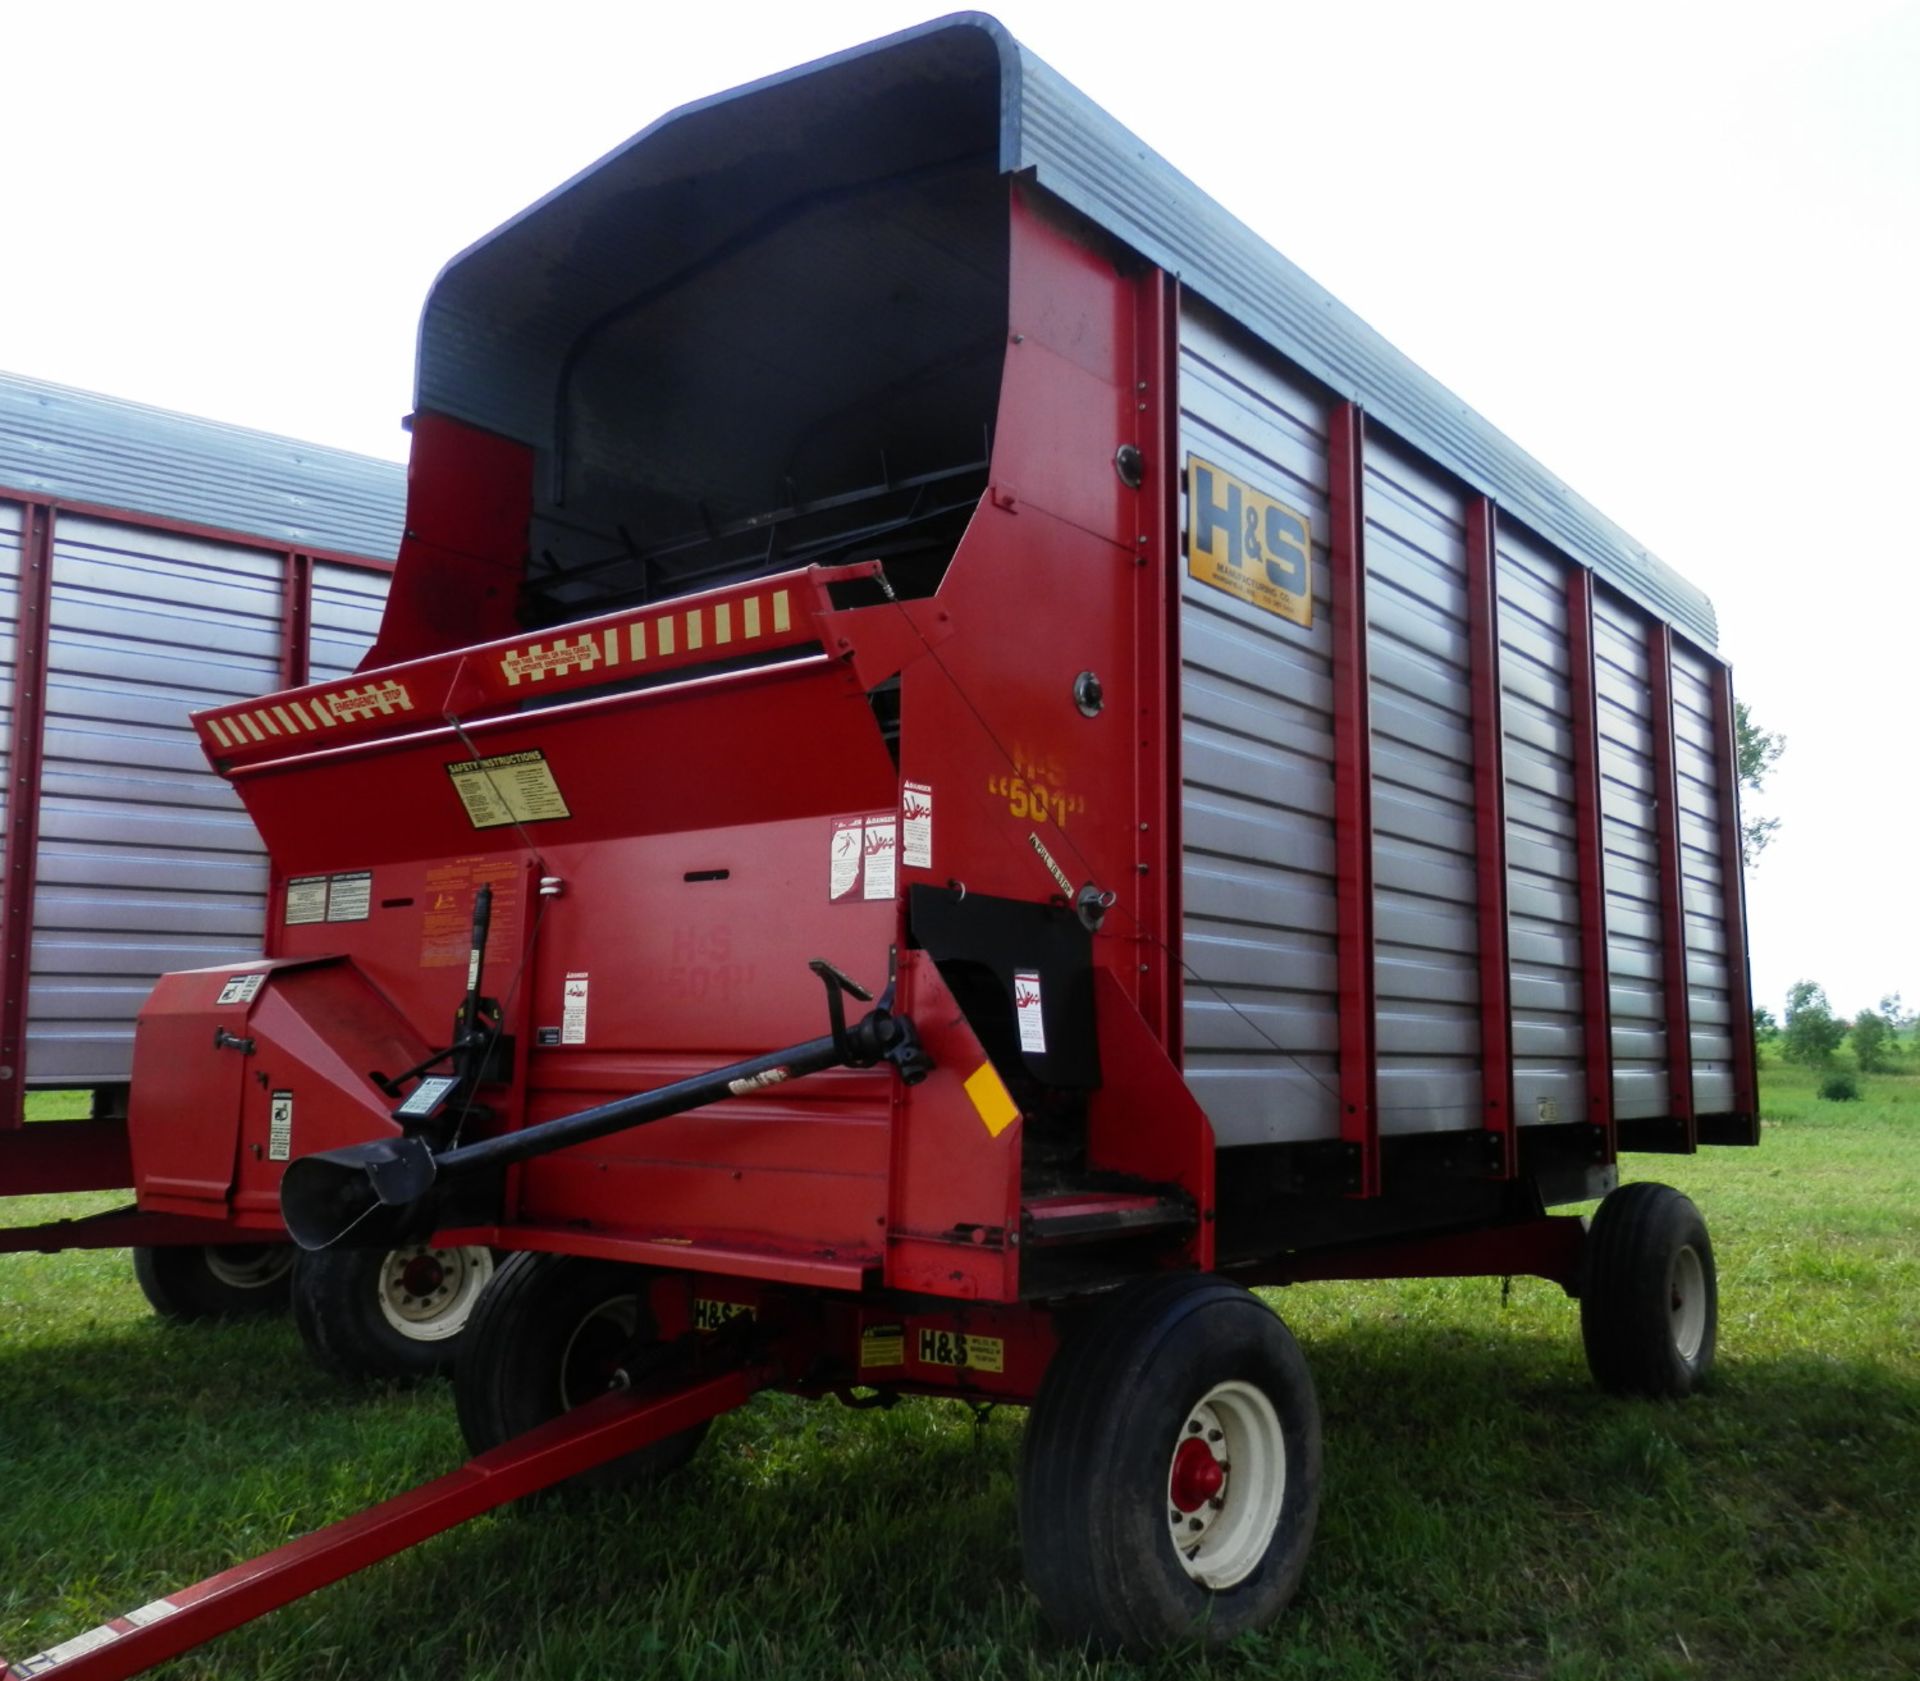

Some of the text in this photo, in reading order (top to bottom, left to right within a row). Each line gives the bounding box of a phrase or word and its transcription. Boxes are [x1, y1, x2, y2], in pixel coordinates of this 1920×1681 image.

[1196, 465, 1306, 597] H&S
[334, 689, 402, 710] EMERGENCY STOP
[448, 761, 479, 772] SAFETY
[920, 1330, 968, 1366] H&S
